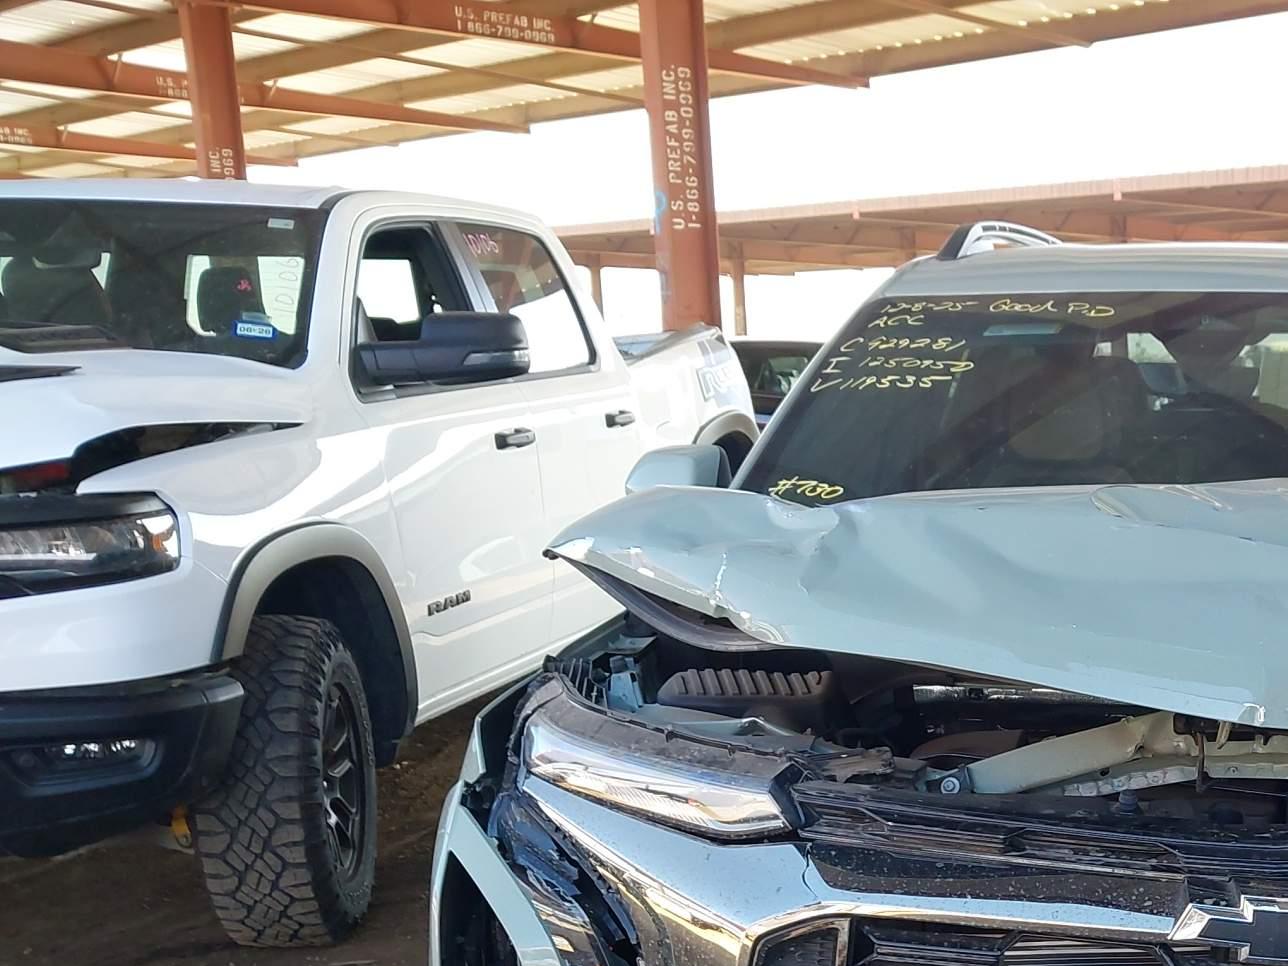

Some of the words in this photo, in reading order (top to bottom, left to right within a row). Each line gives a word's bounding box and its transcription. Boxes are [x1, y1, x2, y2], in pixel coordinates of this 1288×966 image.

[483, 10, 528, 27] PREFAB
[662, 64, 677, 100] INC.
[208, 147, 222, 173] INC.
[664, 109, 682, 184] PREFAB
[677, 66, 702, 228] 1-866-799-0969
[671, 195, 686, 230] U.S.
[427, 589, 471, 617] RAM
